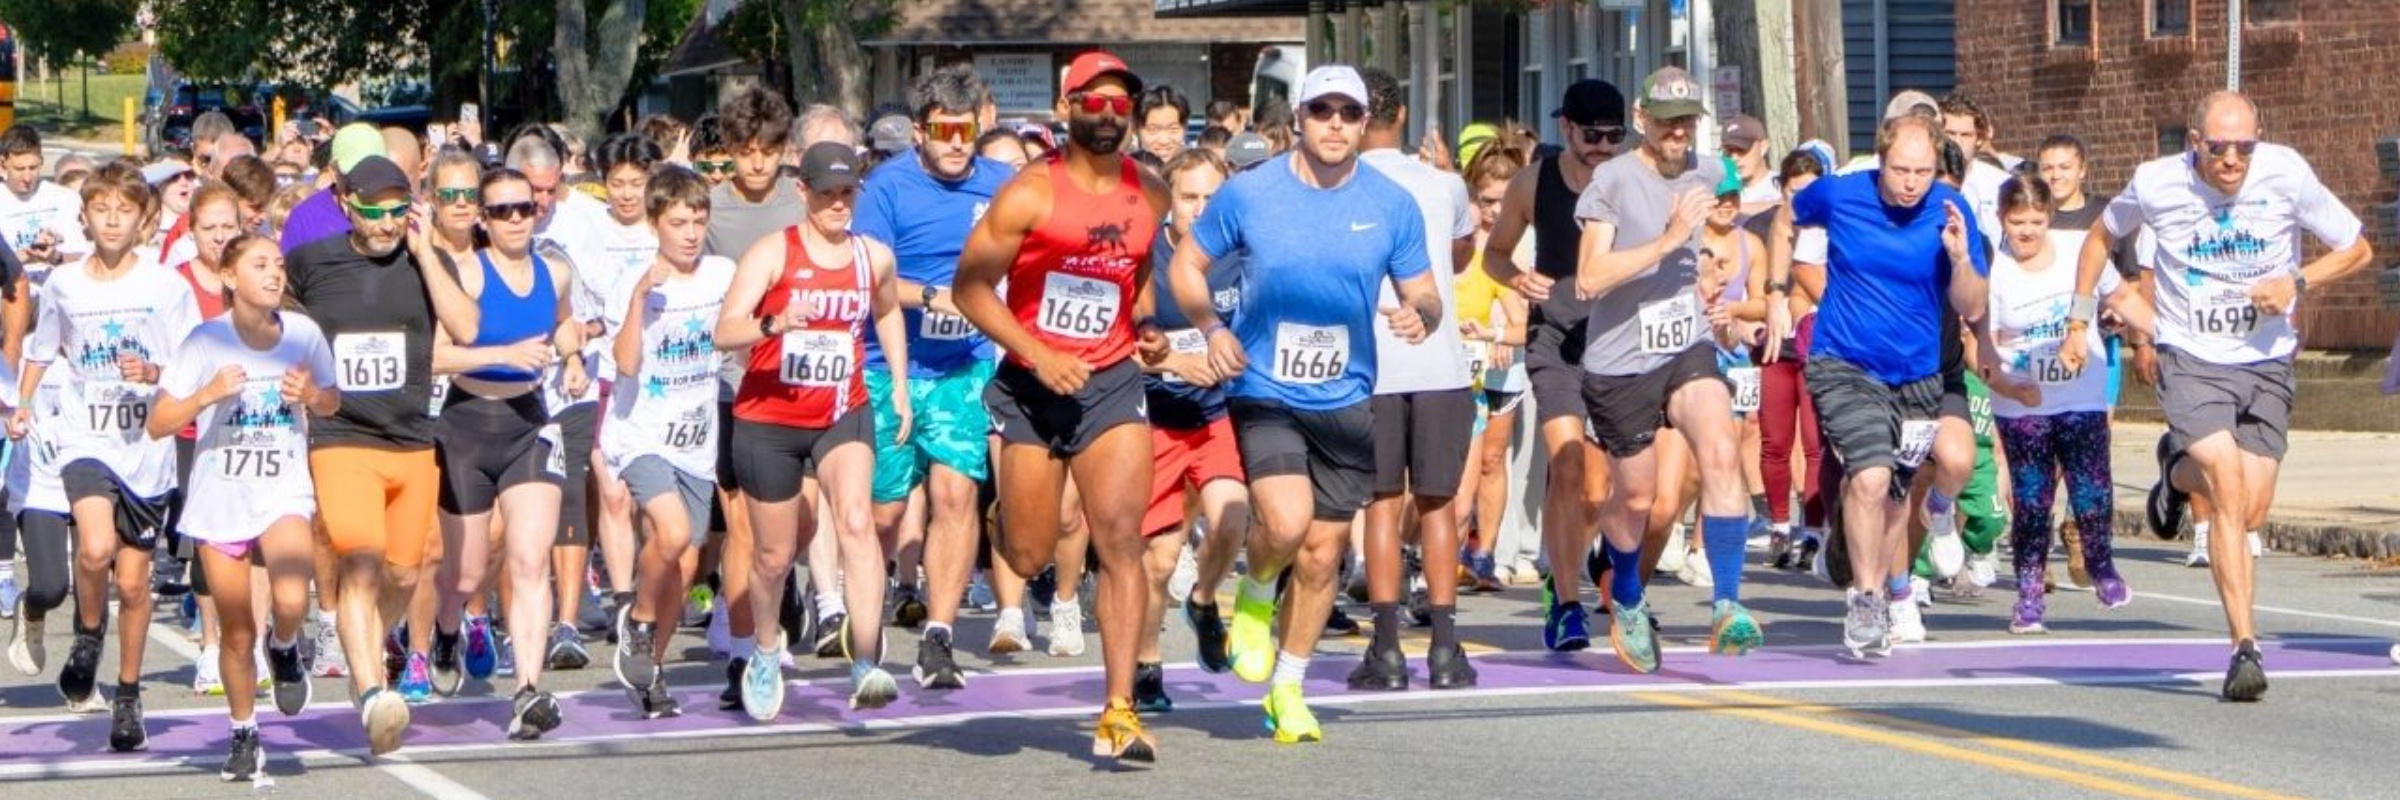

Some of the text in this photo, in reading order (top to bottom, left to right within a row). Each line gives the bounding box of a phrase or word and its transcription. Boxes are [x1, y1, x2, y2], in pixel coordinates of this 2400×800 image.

[1045, 298, 1112, 335] 1665
[2195, 305, 2258, 334] 1699
[1645, 316, 1693, 350] 1687
[343, 356, 398, 386] 1613
[786, 352, 847, 382] 1660
[1280, 348, 1342, 378] 1666
[88, 402, 148, 430] 1709
[664, 421, 708, 448] 1616
[223, 448, 281, 478] 1715
